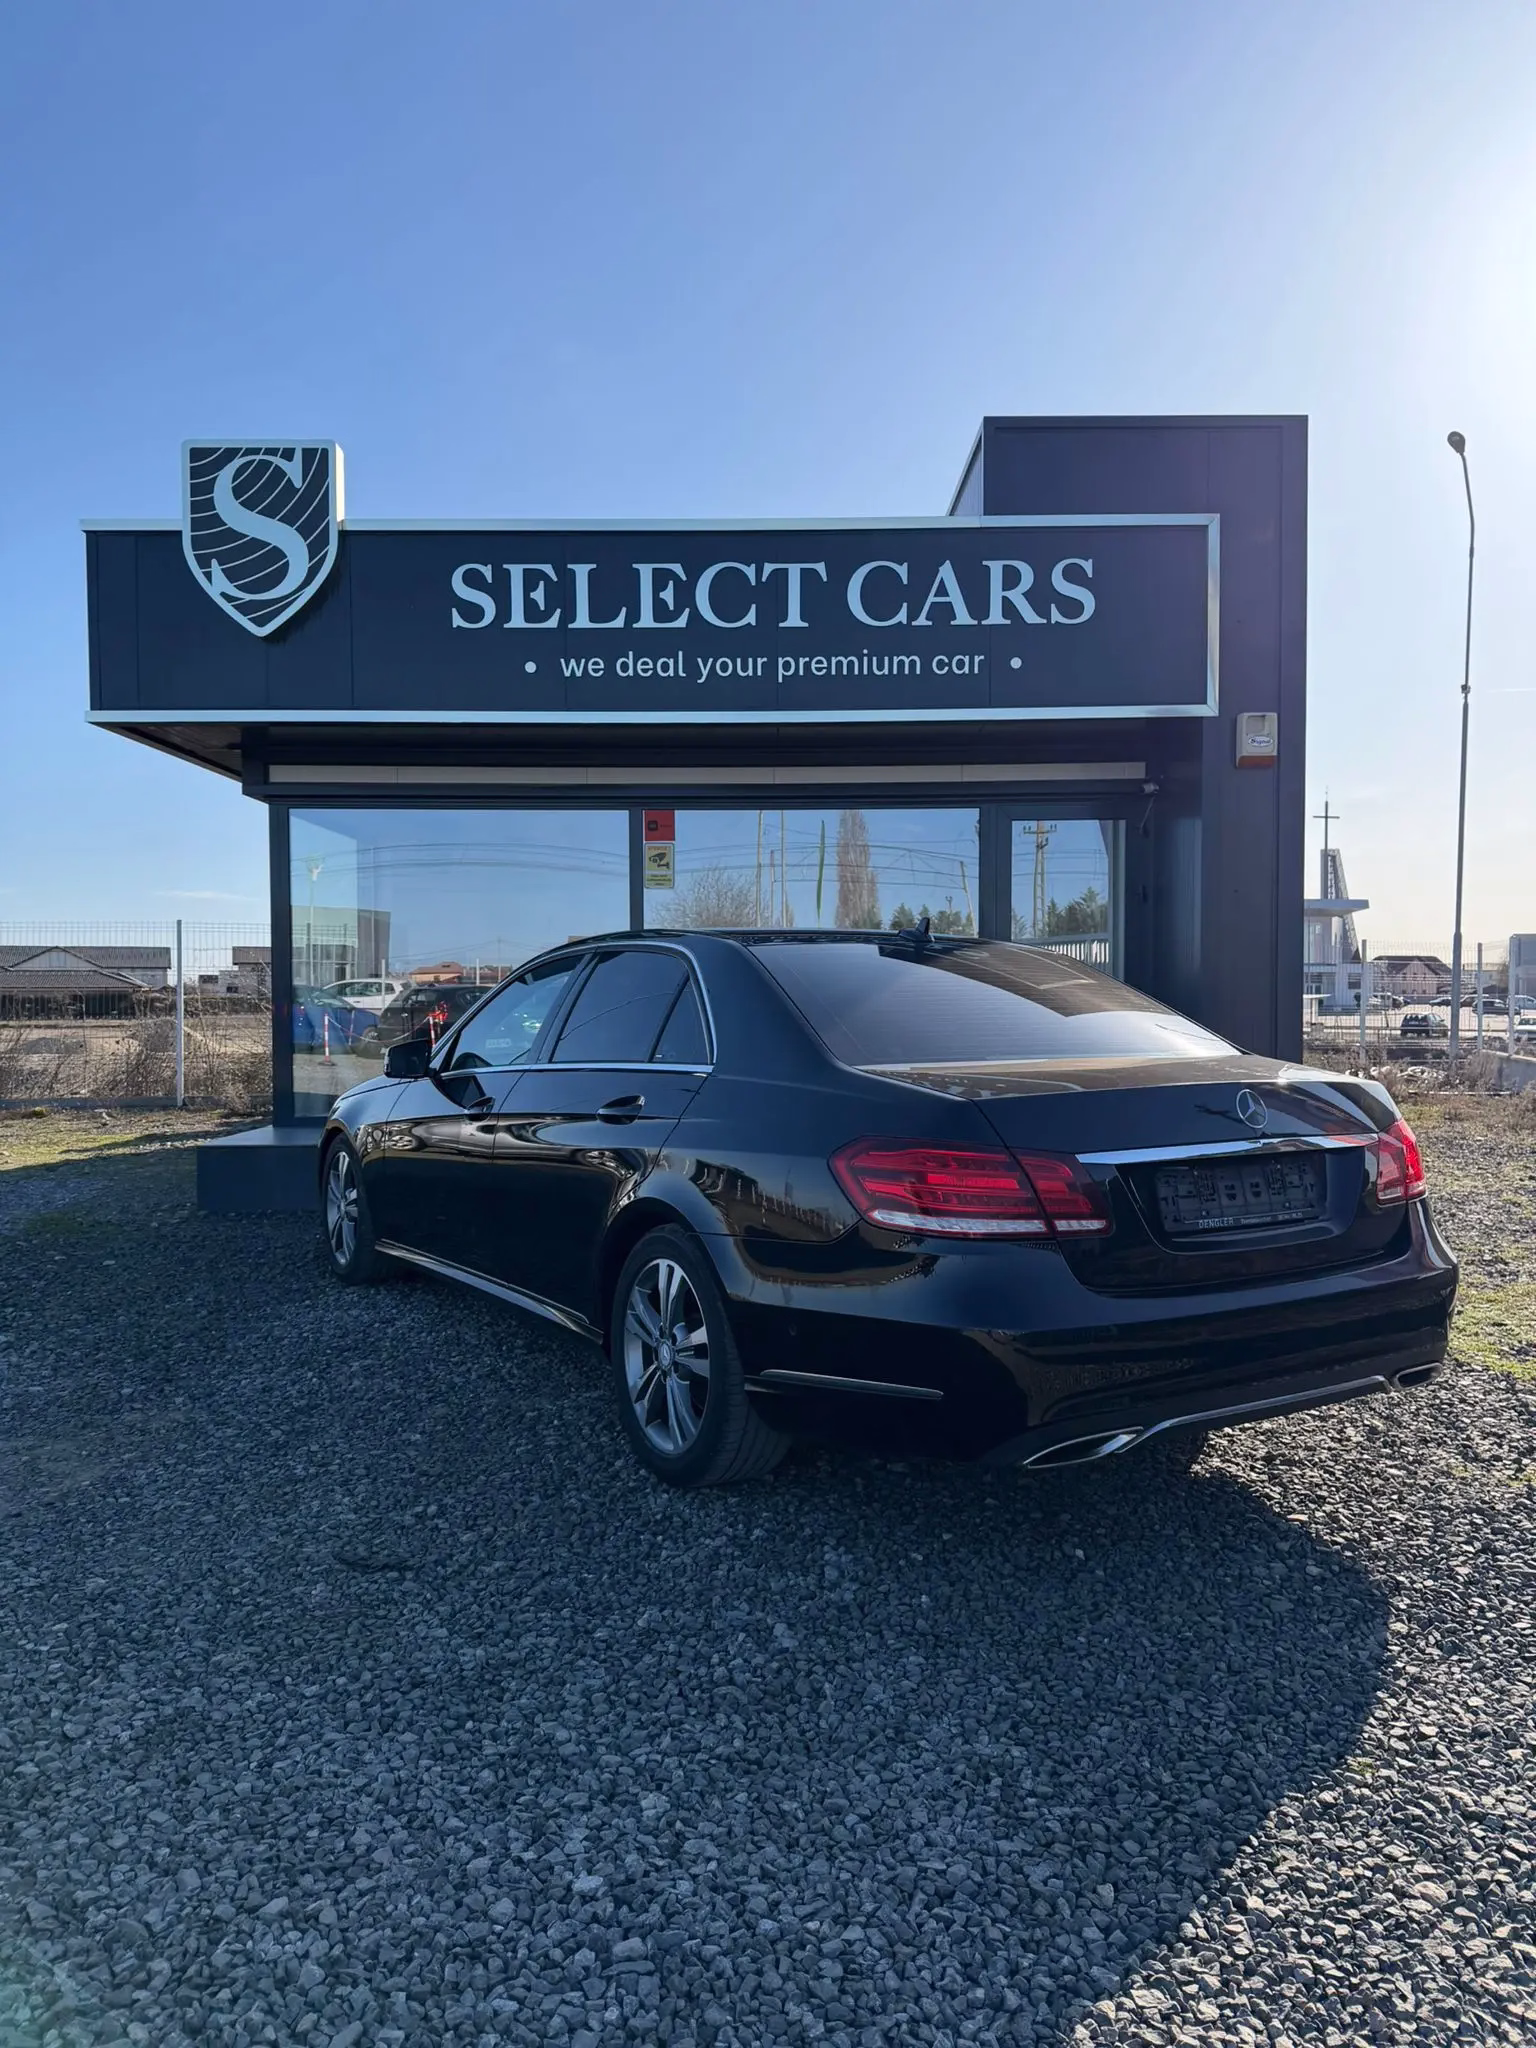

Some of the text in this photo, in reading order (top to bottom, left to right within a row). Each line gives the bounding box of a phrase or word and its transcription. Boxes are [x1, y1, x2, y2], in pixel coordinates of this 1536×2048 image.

[451, 557, 1096, 629] SELECT CARS
[560, 648, 985, 684] we deal your premium car
